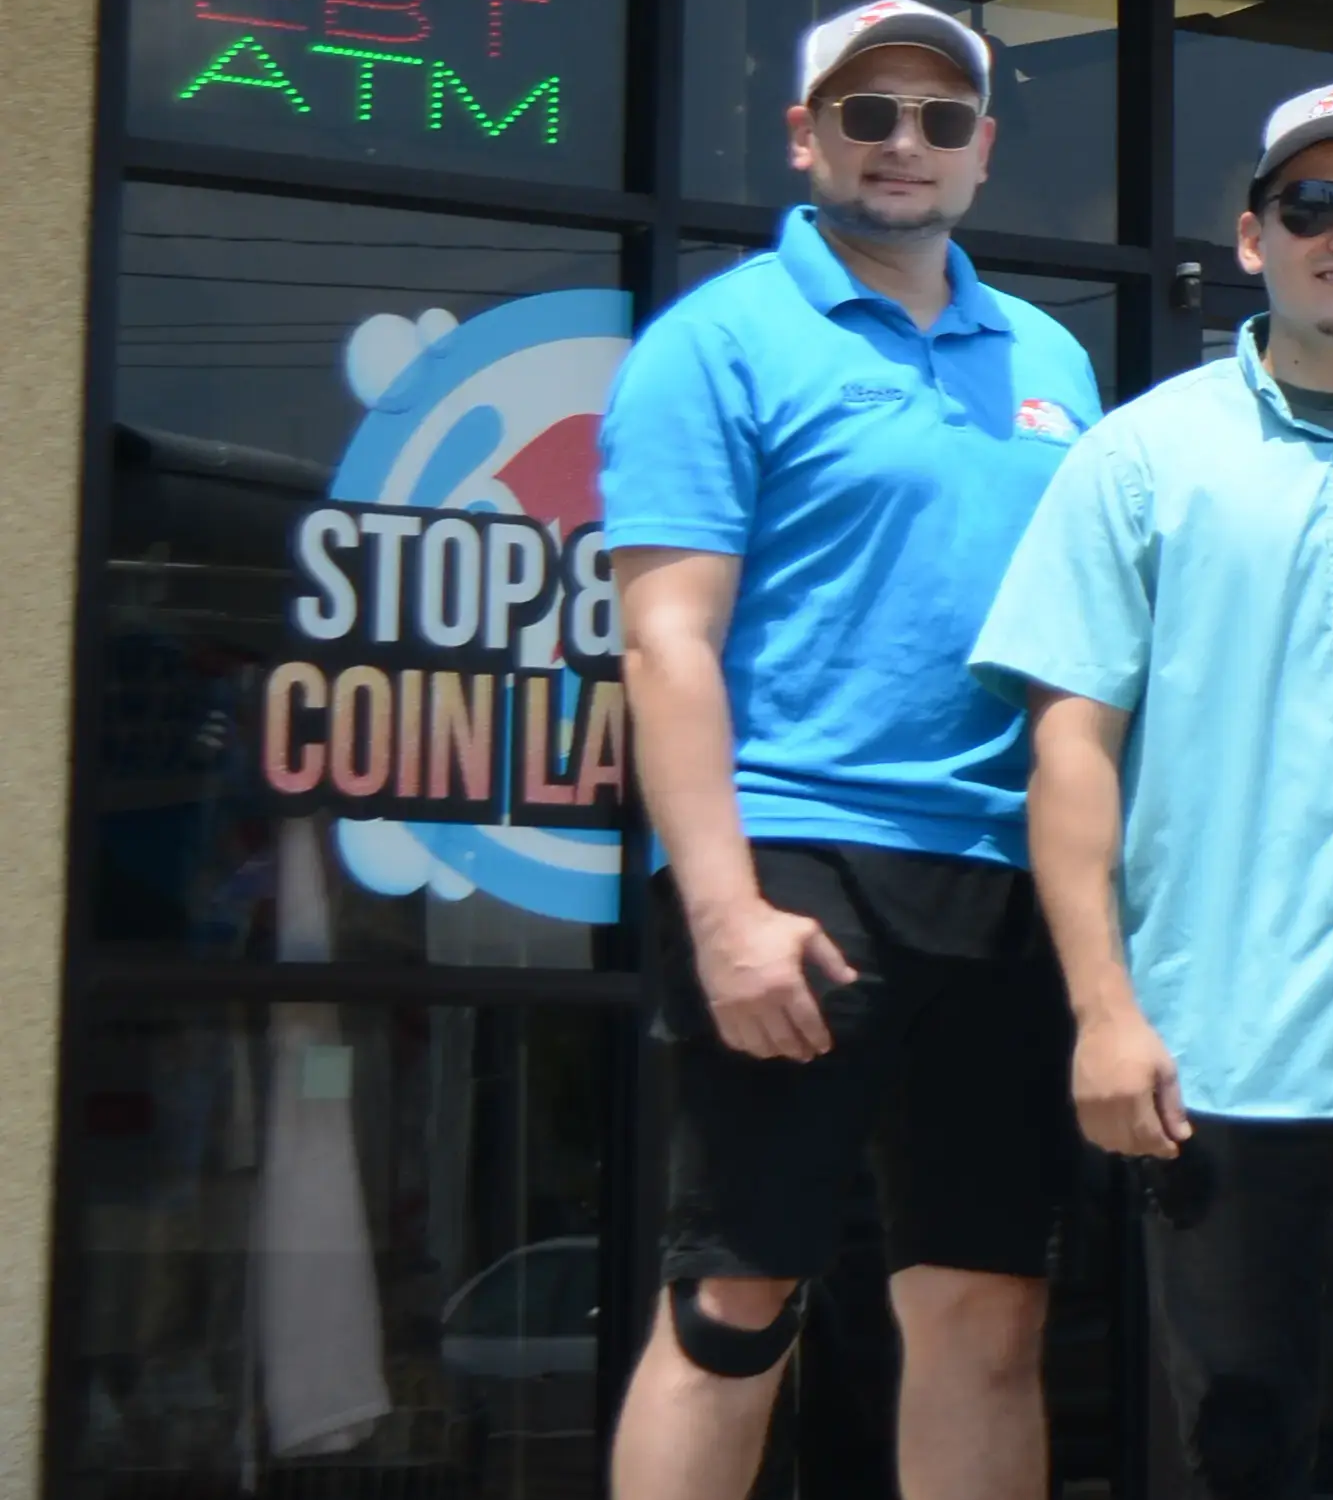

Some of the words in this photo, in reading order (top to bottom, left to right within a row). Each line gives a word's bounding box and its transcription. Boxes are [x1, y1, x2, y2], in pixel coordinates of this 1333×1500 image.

[176, 33, 561, 145] ATM
[297, 508, 546, 650] STOP
[266, 661, 494, 801] COIN
[525, 677, 622, 806] LA
